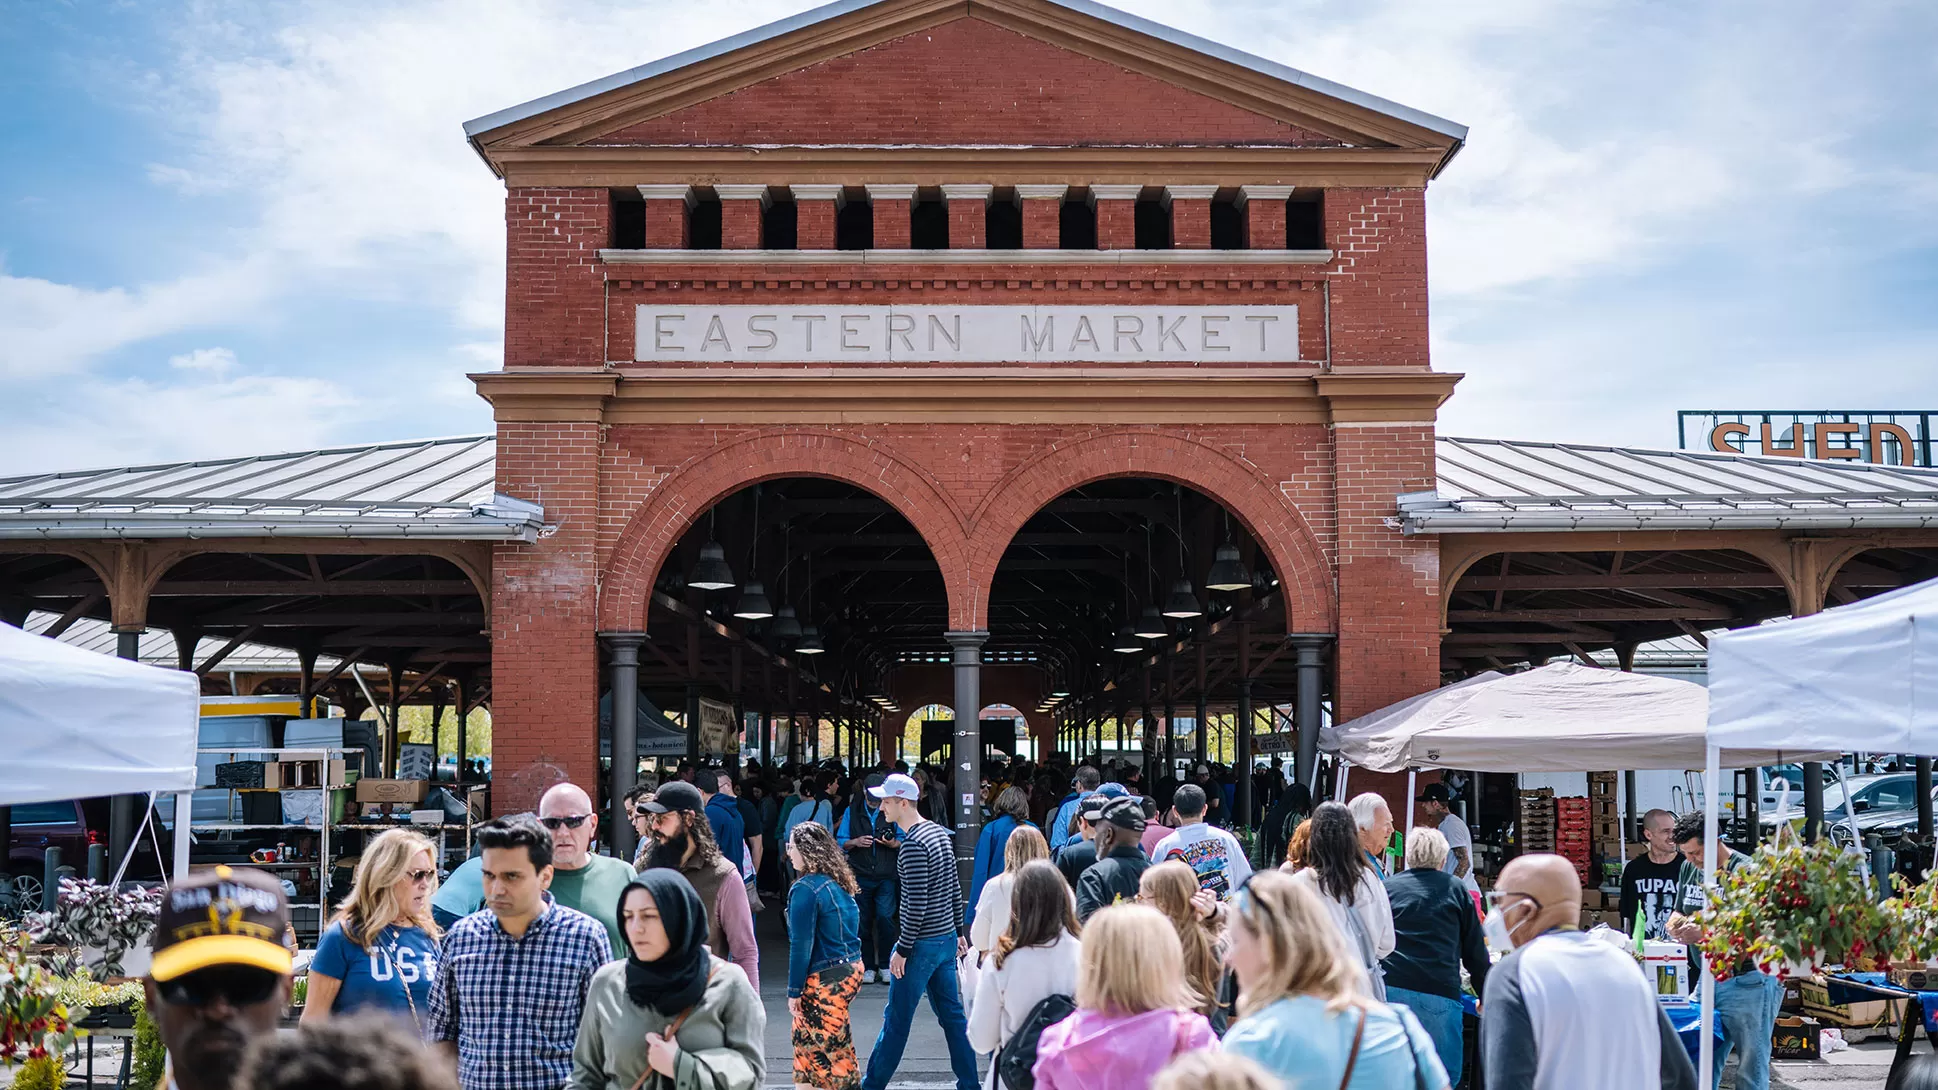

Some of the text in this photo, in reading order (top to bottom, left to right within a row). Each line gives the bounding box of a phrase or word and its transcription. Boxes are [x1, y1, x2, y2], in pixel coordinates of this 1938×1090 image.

[655, 314, 1279, 352] EASTERN MARKET
[1711, 422, 1915, 467] SHED
[1635, 878, 1680, 894] TUPA
